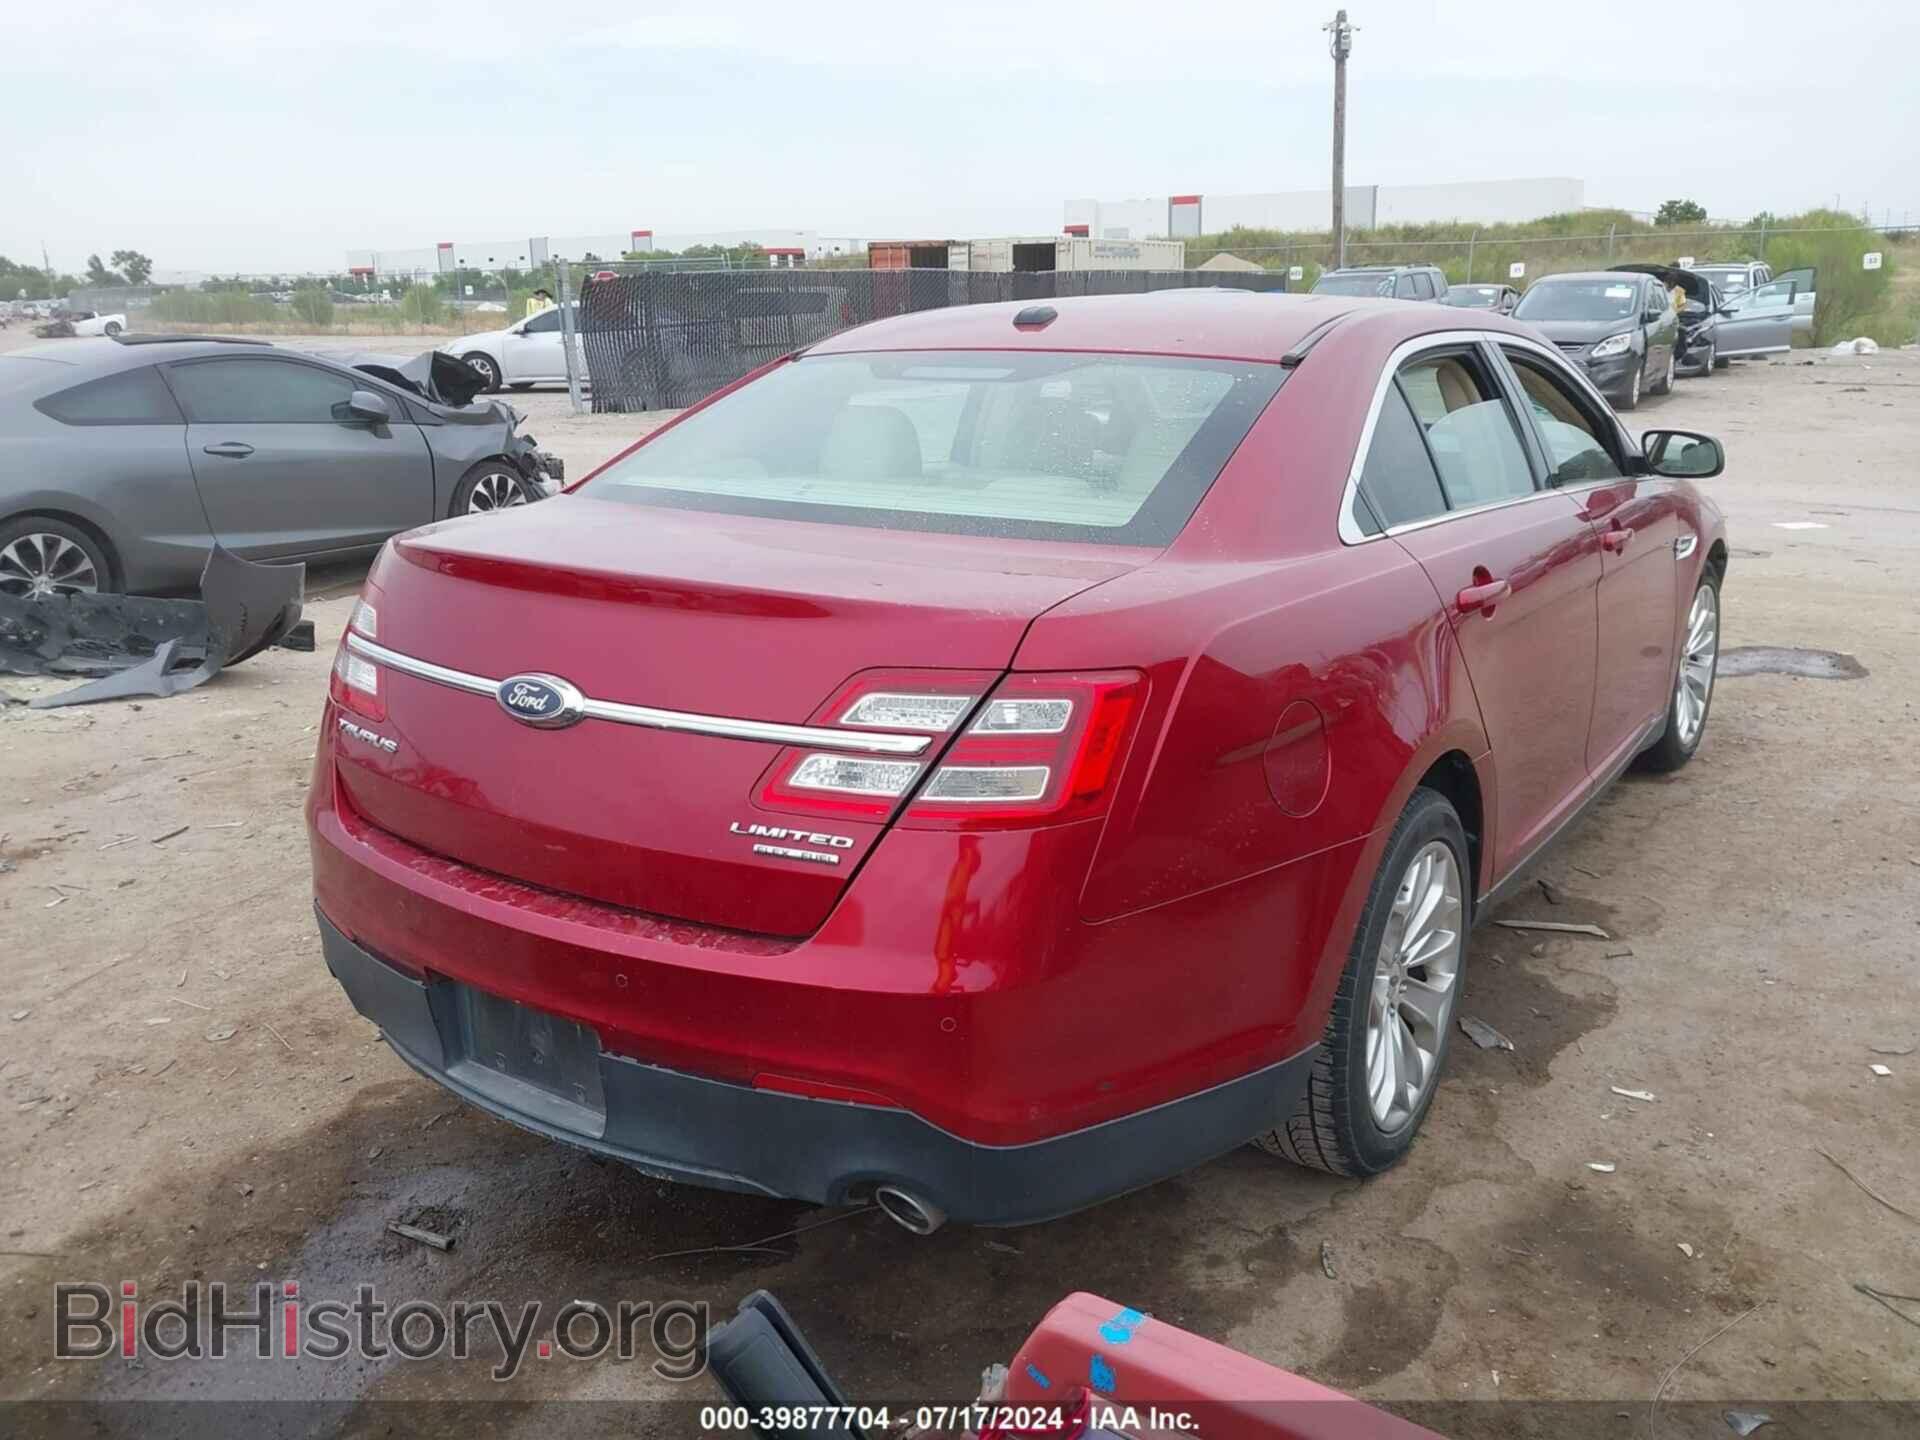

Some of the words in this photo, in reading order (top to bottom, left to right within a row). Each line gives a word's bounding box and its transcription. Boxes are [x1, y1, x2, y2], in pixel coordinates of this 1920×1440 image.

[508, 683, 547, 711] Ford
[338, 717, 397, 752] TAURUS
[730, 822, 854, 848] LIMITED
